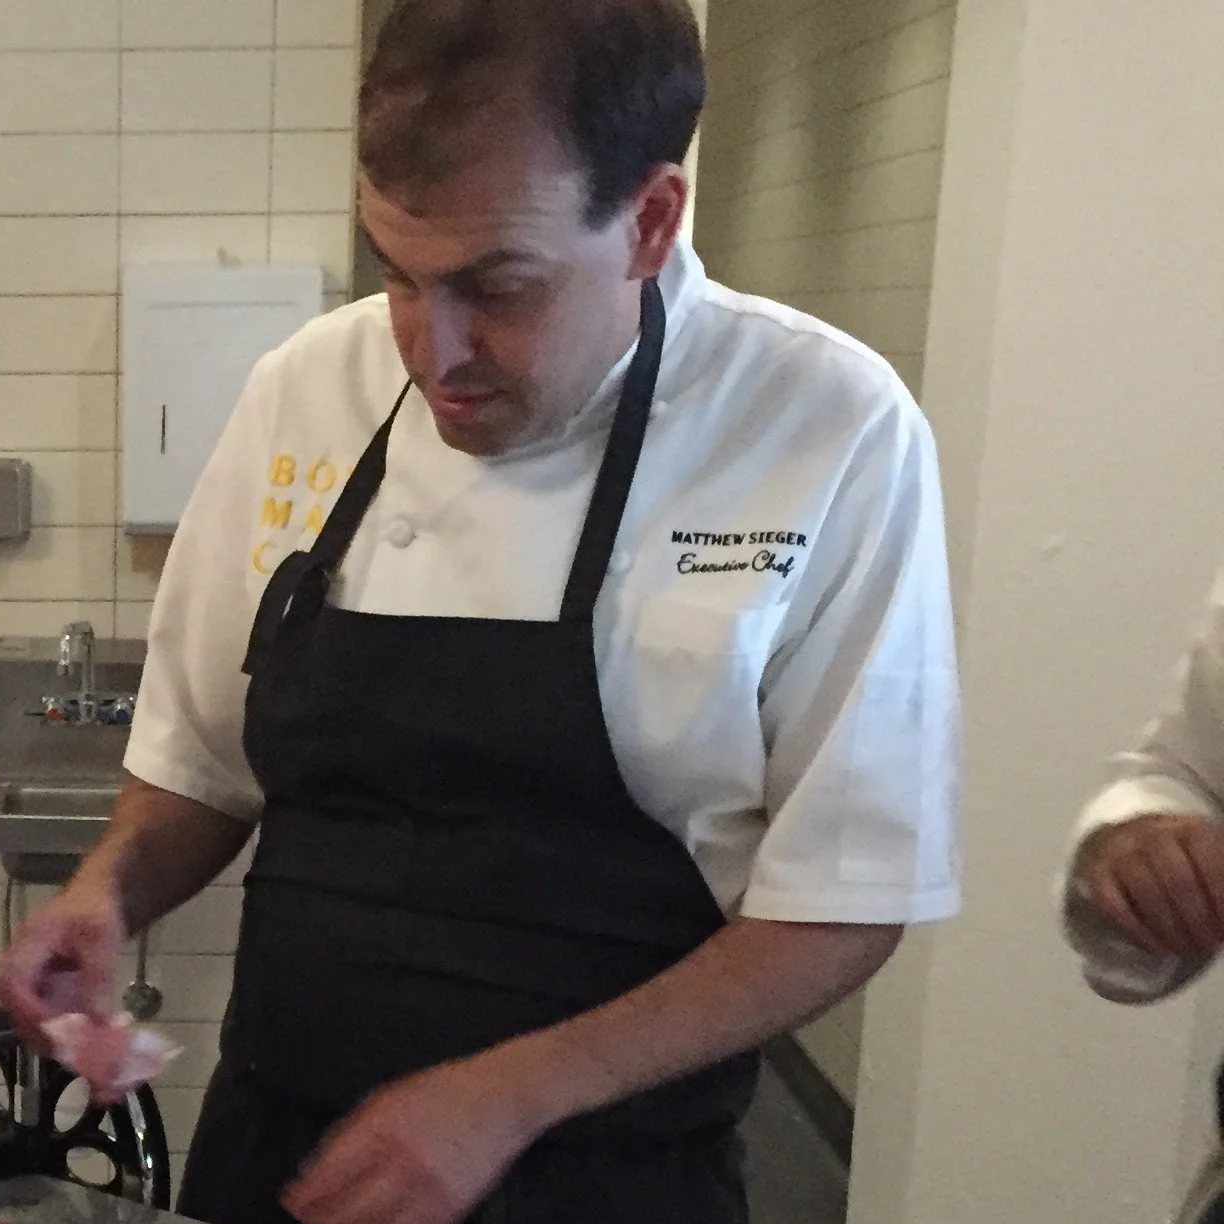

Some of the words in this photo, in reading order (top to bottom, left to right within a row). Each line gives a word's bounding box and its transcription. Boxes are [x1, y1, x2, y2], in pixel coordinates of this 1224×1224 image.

[671, 530, 746, 547] MATTHEW
[748, 530, 807, 547] SIEGER
[677, 552, 749, 575] Executive
[751, 549, 795, 579] Chef
